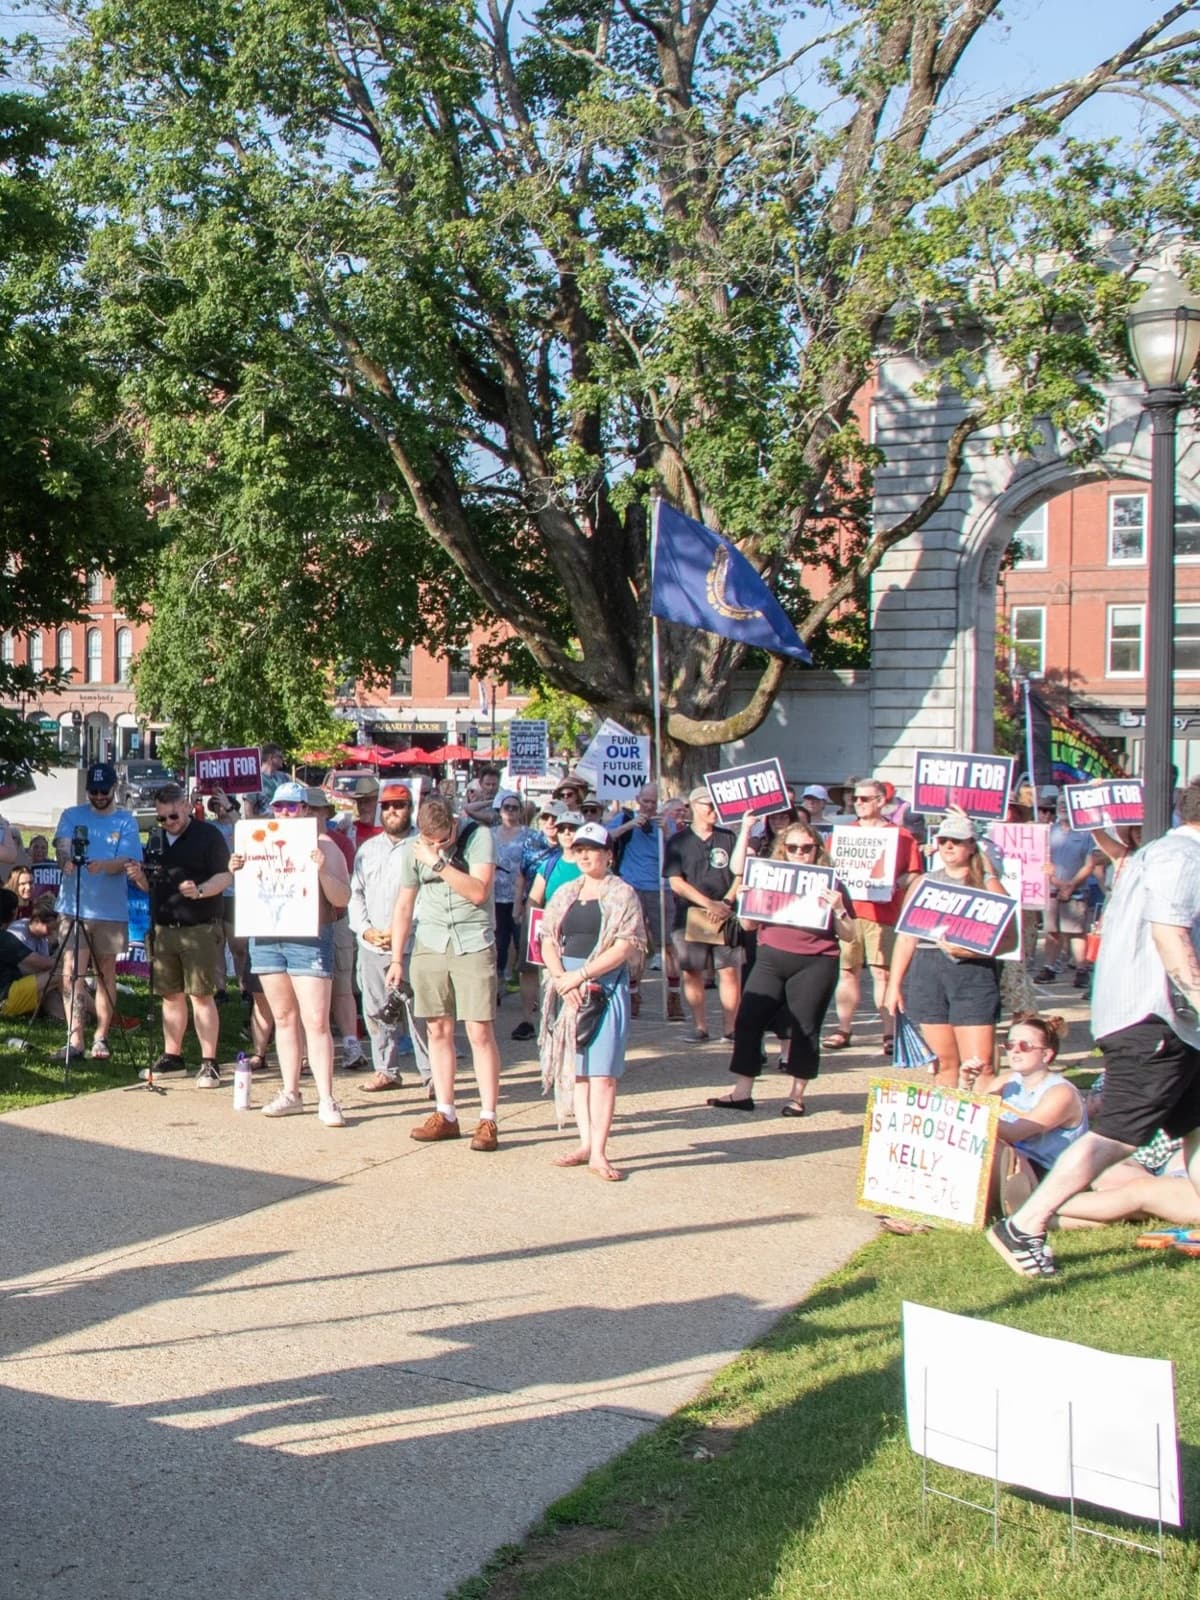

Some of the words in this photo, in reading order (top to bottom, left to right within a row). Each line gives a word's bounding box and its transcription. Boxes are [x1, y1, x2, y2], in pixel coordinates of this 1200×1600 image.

[516, 744, 540, 756] OFF!
[607, 745, 641, 759] OUR
[611, 736, 638, 745] FUND
[199, 758, 231, 779] FIGHT
[233, 756, 258, 777] FOR
[603, 761, 644, 771] FUTURE
[918, 758, 969, 787] FIGHT
[969, 762, 1007, 791] FOR
[603, 774, 647, 788] NOW
[711, 776, 749, 804] FIGHT
[747, 769, 781, 797] FOR
[1070, 785, 1111, 810] FIGHT
[1112, 784, 1143, 805] FOR
[836, 846, 877, 859] GHOULS
[837, 836, 888, 848] BELLIGERENT
[748, 862, 797, 894] FIGHT
[914, 886, 973, 916] FIGHT
[964, 896, 1009, 926] FOR
[873, 1086, 899, 1105] THE
[905, 1085, 981, 1125] BUDGET
[869, 1112, 883, 1133] IS
[887, 1111, 898, 1132] A
[901, 1112, 989, 1160] PROBLEM
[888, 1141, 944, 1173] KELLY
